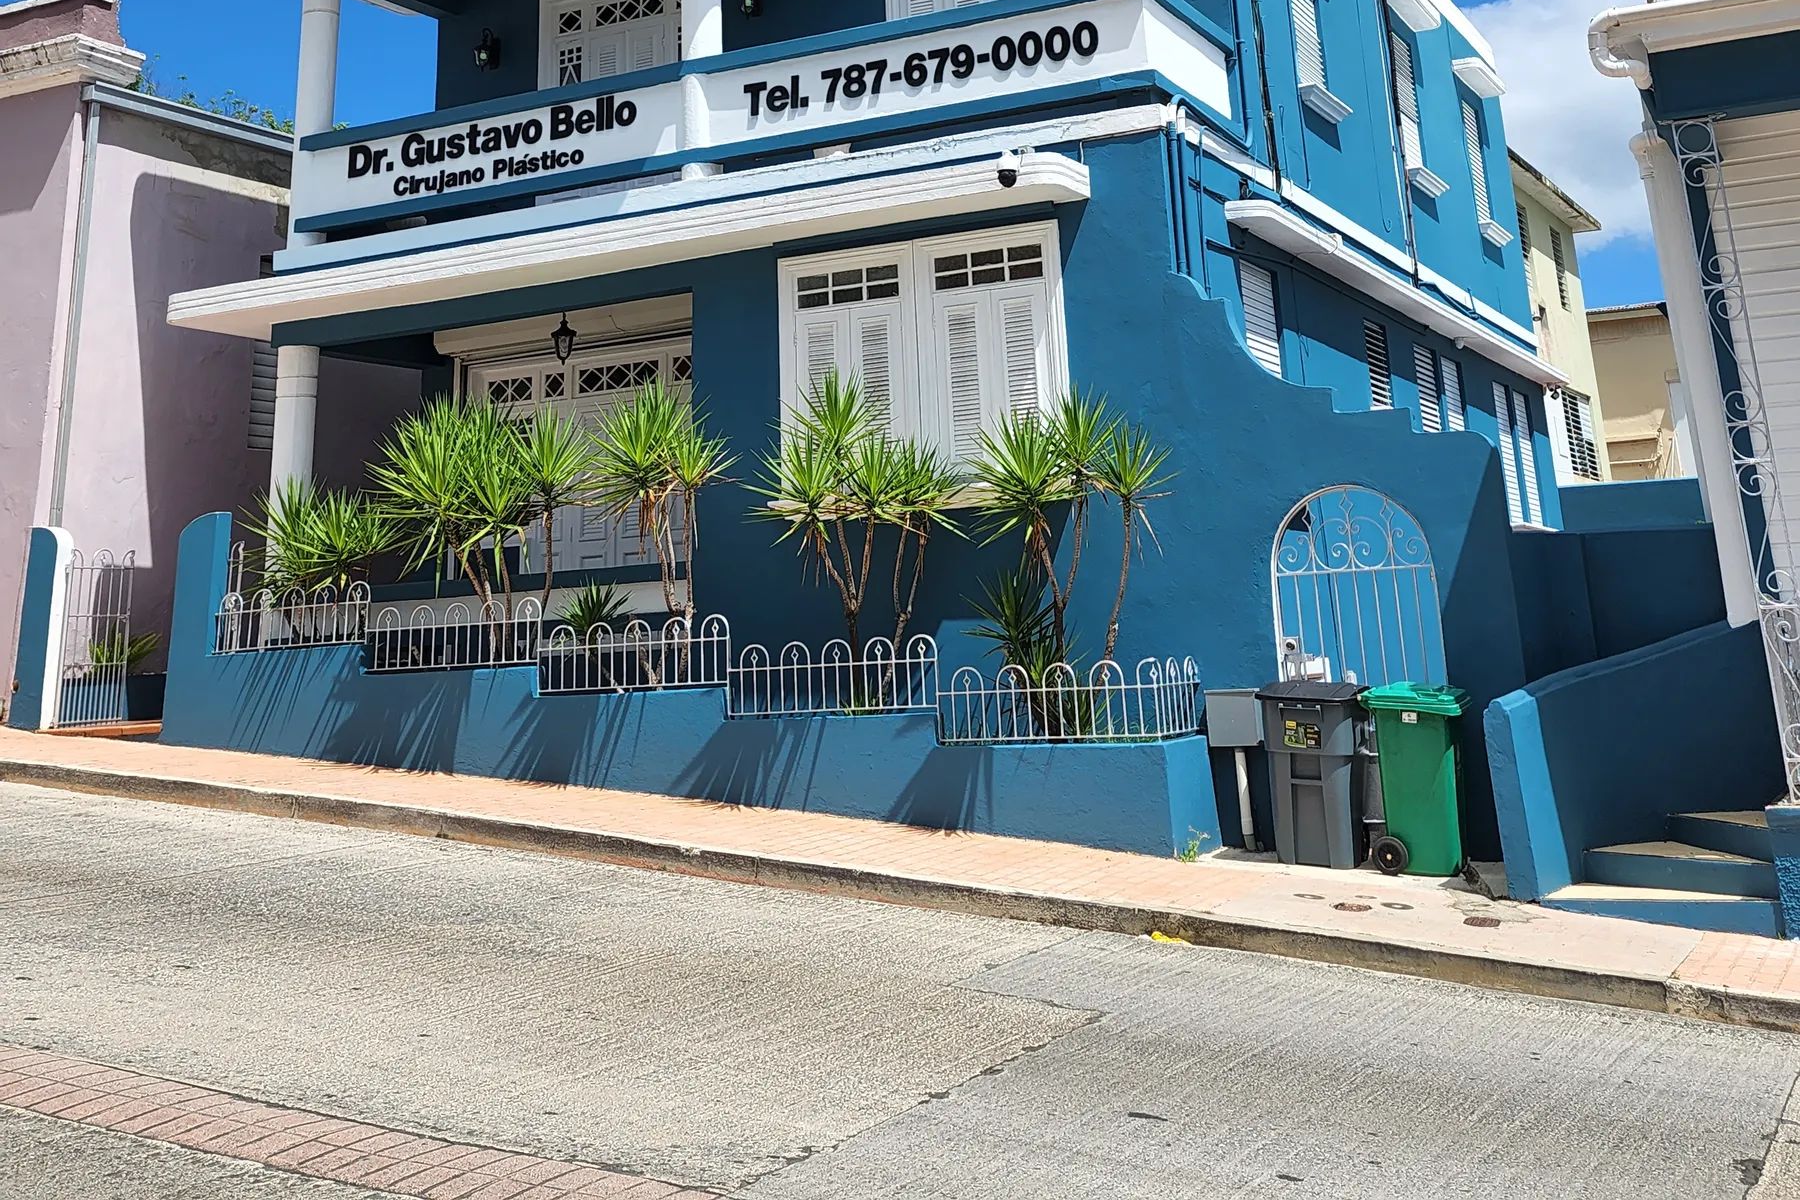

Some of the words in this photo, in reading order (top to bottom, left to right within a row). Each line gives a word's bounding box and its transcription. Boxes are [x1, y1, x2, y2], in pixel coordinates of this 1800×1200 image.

[744, 75, 809, 117] Tel.
[820, 20, 1099, 104] 787-679-0000
[348, 145, 395, 178] Dr.
[401, 118, 543, 168] Gustavo
[550, 95, 637, 141] Bello
[393, 166, 485, 196] Cirujano
[492, 149, 585, 179] Plástico
